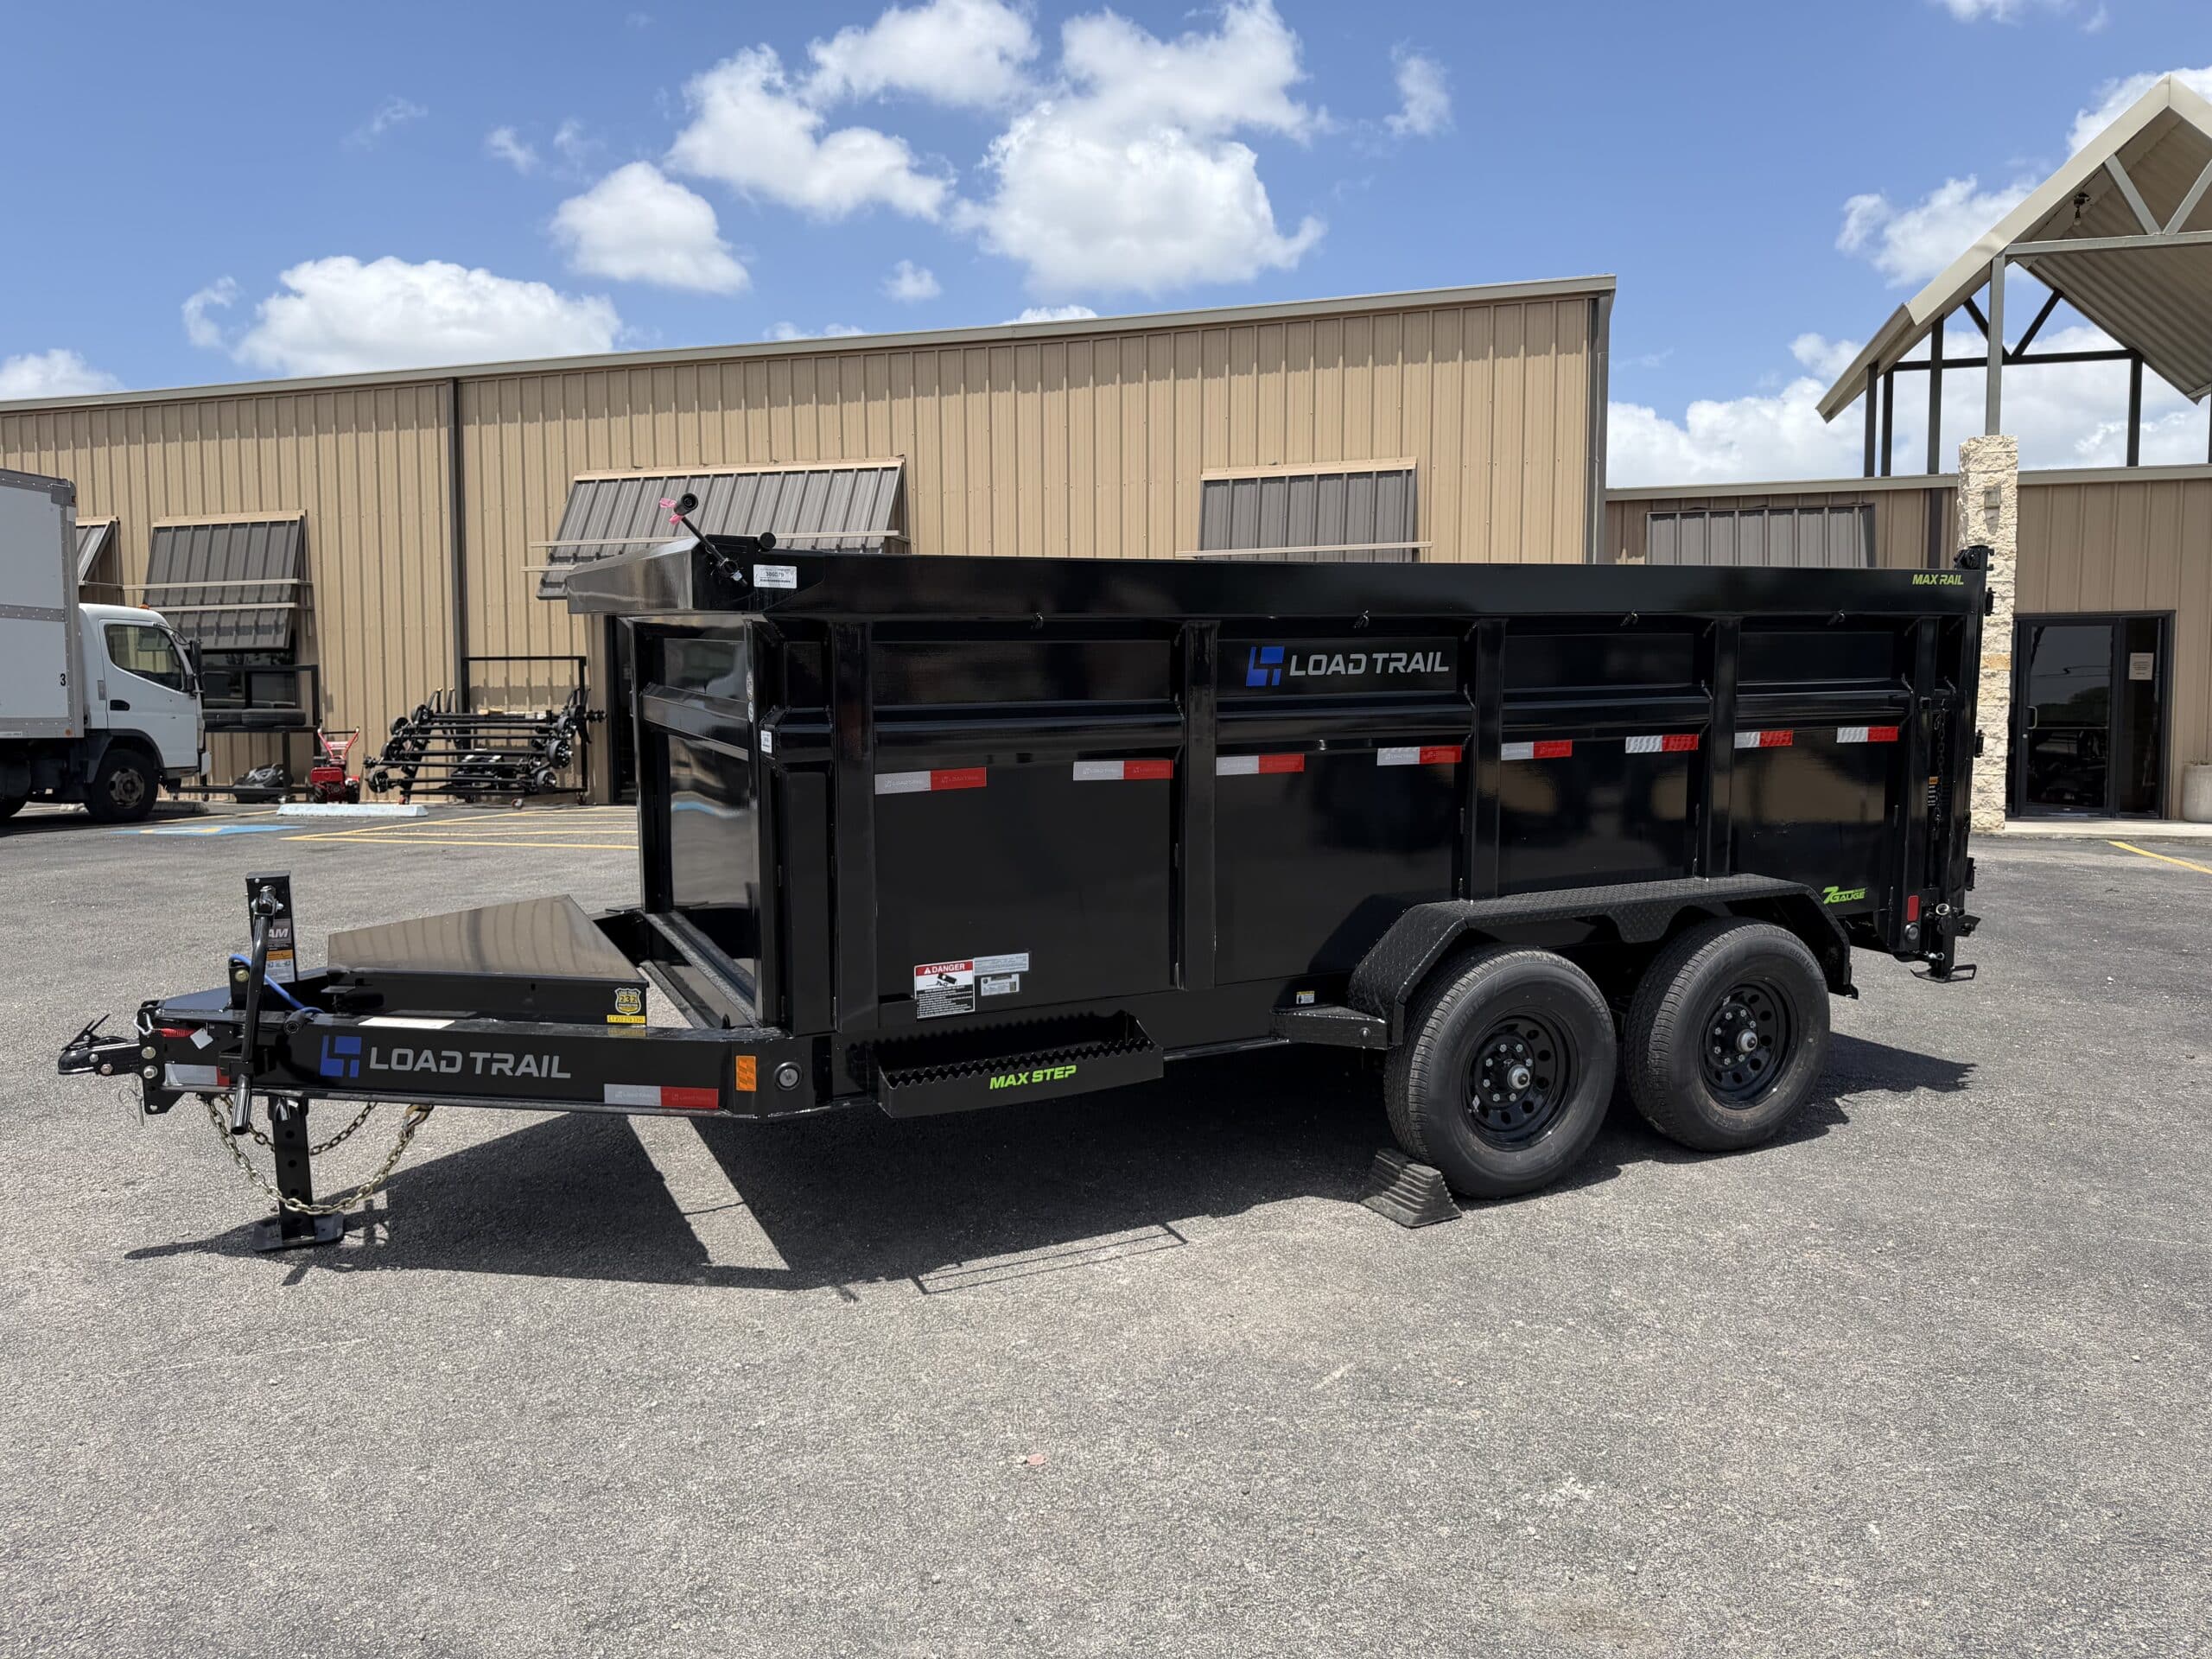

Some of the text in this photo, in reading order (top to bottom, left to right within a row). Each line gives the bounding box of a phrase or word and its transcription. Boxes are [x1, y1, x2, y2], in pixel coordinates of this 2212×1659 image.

[1912, 574, 1964, 585] MAX RAIL
[1289, 652, 1449, 677] LOAD TRAIL
[60, 673, 67, 686] 3
[268, 928, 289, 938] AM
[931, 963, 965, 973] DANGER
[370, 1046, 571, 1079] LOAD TRAIL
[989, 1065, 1077, 1090] MAX STEP
